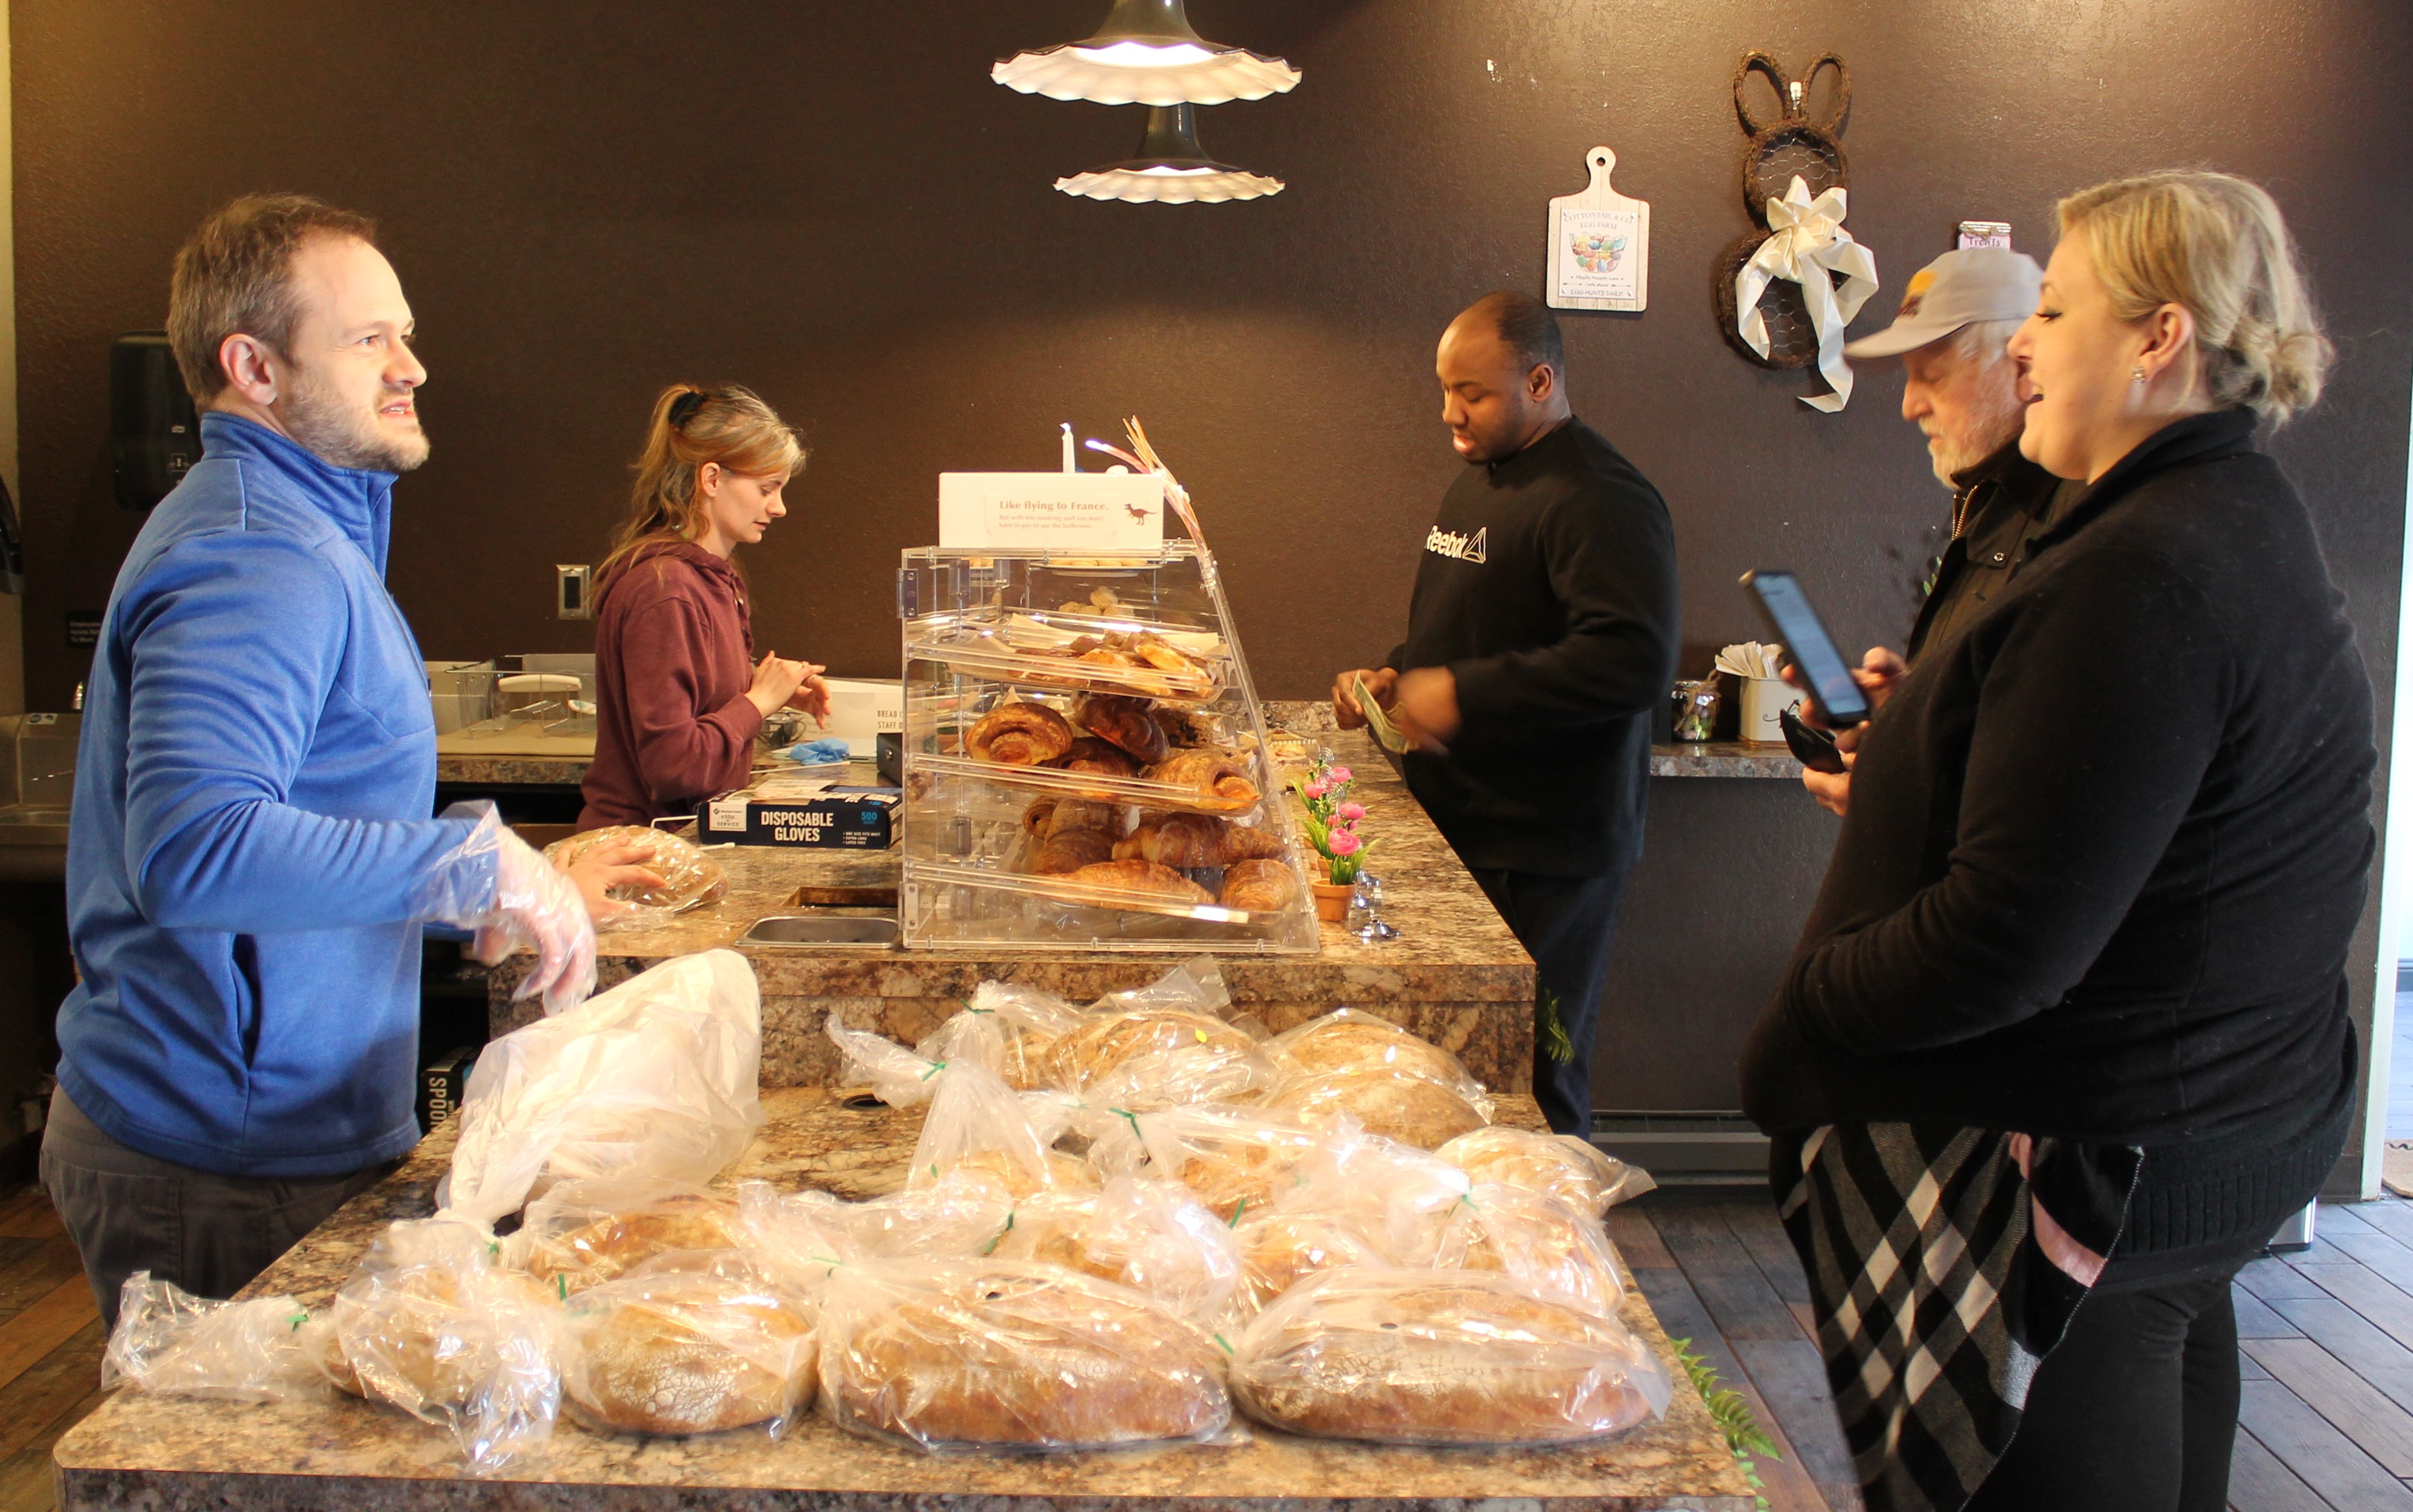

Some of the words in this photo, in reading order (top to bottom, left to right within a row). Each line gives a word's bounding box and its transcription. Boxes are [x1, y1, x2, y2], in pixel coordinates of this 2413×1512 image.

[1564, 212, 1613, 223] COTTONTAIL
[1969, 237, 2000, 247] Treats
[999, 500, 1021, 509] Like
[1024, 500, 1054, 512] flying
[1057, 501, 1067, 510] to
[1070, 502, 1110, 510] France.
[1425, 524, 1468, 559] Reebok
[877, 721, 897, 729] STAFF
[761, 811, 834, 827] DISPOSABLE
[862, 811, 877, 820] 500
[774, 827, 820, 842] GLOVES
